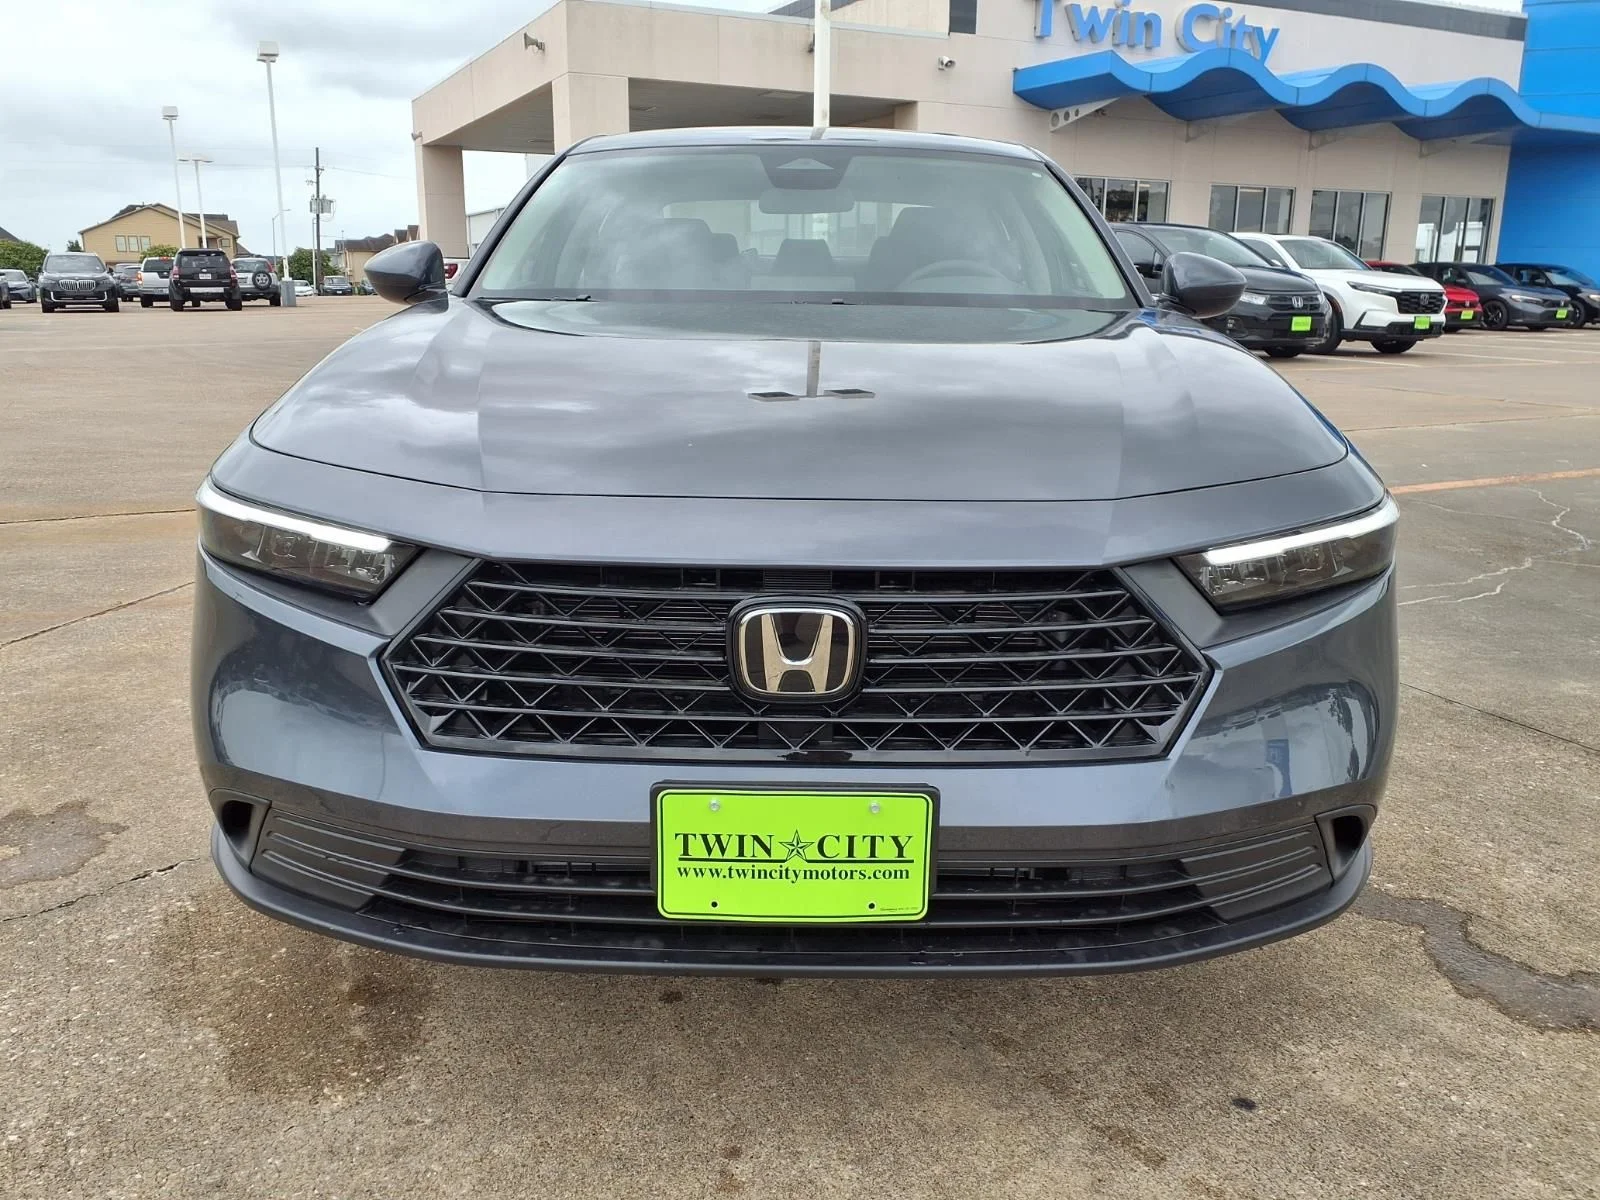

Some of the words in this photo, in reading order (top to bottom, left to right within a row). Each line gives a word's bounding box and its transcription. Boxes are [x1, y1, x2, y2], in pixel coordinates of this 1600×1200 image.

[1180, 3, 1280, 65] City
[674, 832, 775, 859] TWIN
[817, 833, 914, 859] CITY
[677, 864, 910, 884] www.twincitymotors.com
